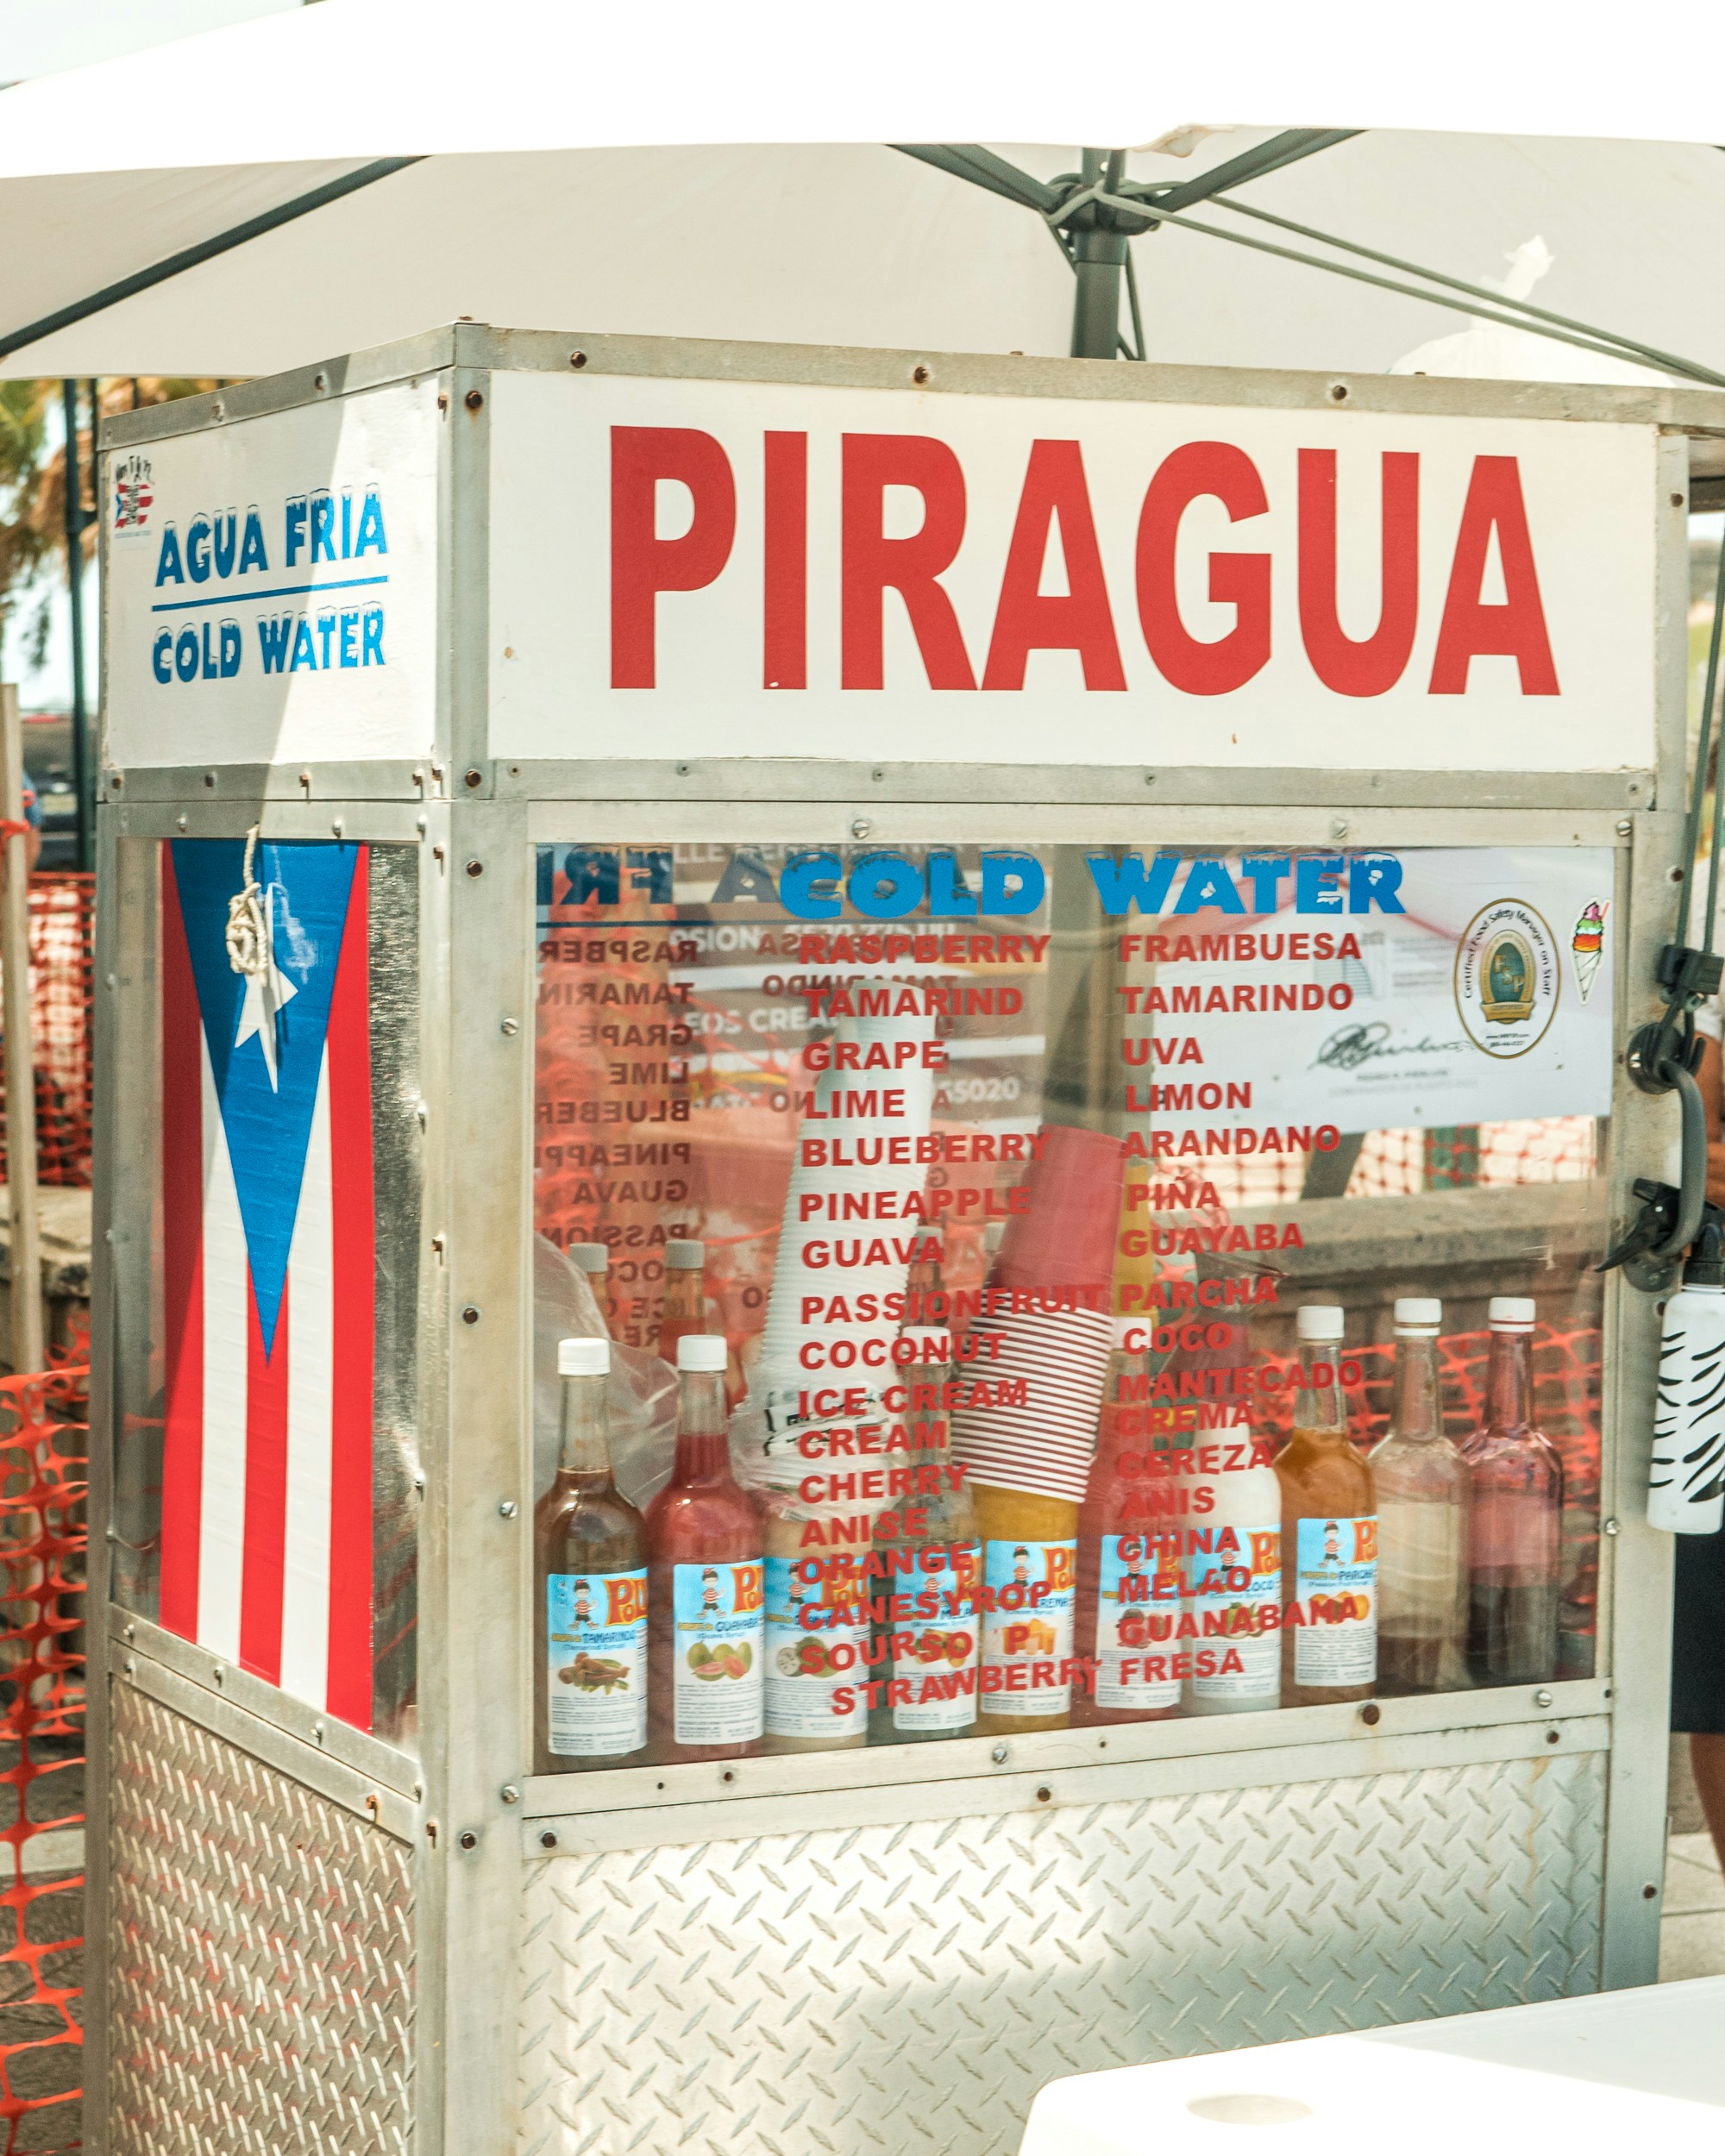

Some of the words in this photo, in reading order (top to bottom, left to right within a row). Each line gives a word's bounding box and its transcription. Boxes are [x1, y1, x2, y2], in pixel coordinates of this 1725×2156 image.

[154, 504, 268, 586] AGUA
[285, 483, 388, 567] FRIA
[612, 426, 1559, 697] PIRAGUA
[153, 618, 242, 684] COLD
[257, 601, 387, 674] WATER
[780, 849, 1045, 919] COLD
[1087, 850, 1406, 915] WATER
[799, 935, 1051, 964] RASPBERRY
[1120, 933, 1362, 962] FRAMBUESA
[1540, 950, 1549, 965] on
[800, 987, 1024, 1018] TAMARIND
[1120, 983, 1353, 1014] TAMARINDO
[802, 1040, 945, 1071] GRAPE
[1123, 1037, 1203, 1067] UVA
[805, 1089, 906, 1119] LIME
[1126, 1082, 1251, 1112] LIMON
[802, 1133, 1052, 1167] BLUEBERRY
[1123, 1125, 1340, 1159] ARANDANO
[799, 1187, 1033, 1222] PINEAPPLE
[1126, 1175, 1220, 1212] PIÑA
[802, 1236, 945, 1269] GUAVA
[1121, 1223, 1304, 1257] GUAYABA
[800, 1284, 1104, 1325] PASSIONFRUIT
[1121, 1277, 1278, 1311] PARCHA
[799, 1332, 1007, 1369] COCONUT
[1124, 1322, 1233, 1355] COCO
[799, 1388, 866, 1418] ICE
[882, 1379, 1027, 1414] CREAM
[1120, 1360, 1363, 1401] MANTECADO
[1114, 1401, 1254, 1437] CREMA
[799, 1420, 946, 1459] CREAM
[1117, 1443, 1273, 1479] CEREZA
[799, 1464, 969, 1503] CHERRY
[1120, 1486, 1216, 1520] ANIS
[800, 1508, 928, 1546] ANISE
[1117, 1526, 1240, 1562] CHINA
[798, 1543, 973, 1584] ORANGE
[799, 1581, 1051, 1630] CANESYROP
[800, 1632, 973, 1675] SOURSO
[1120, 1648, 1244, 1685] FRESA
[831, 1656, 1102, 1715] STRAWBERRY
